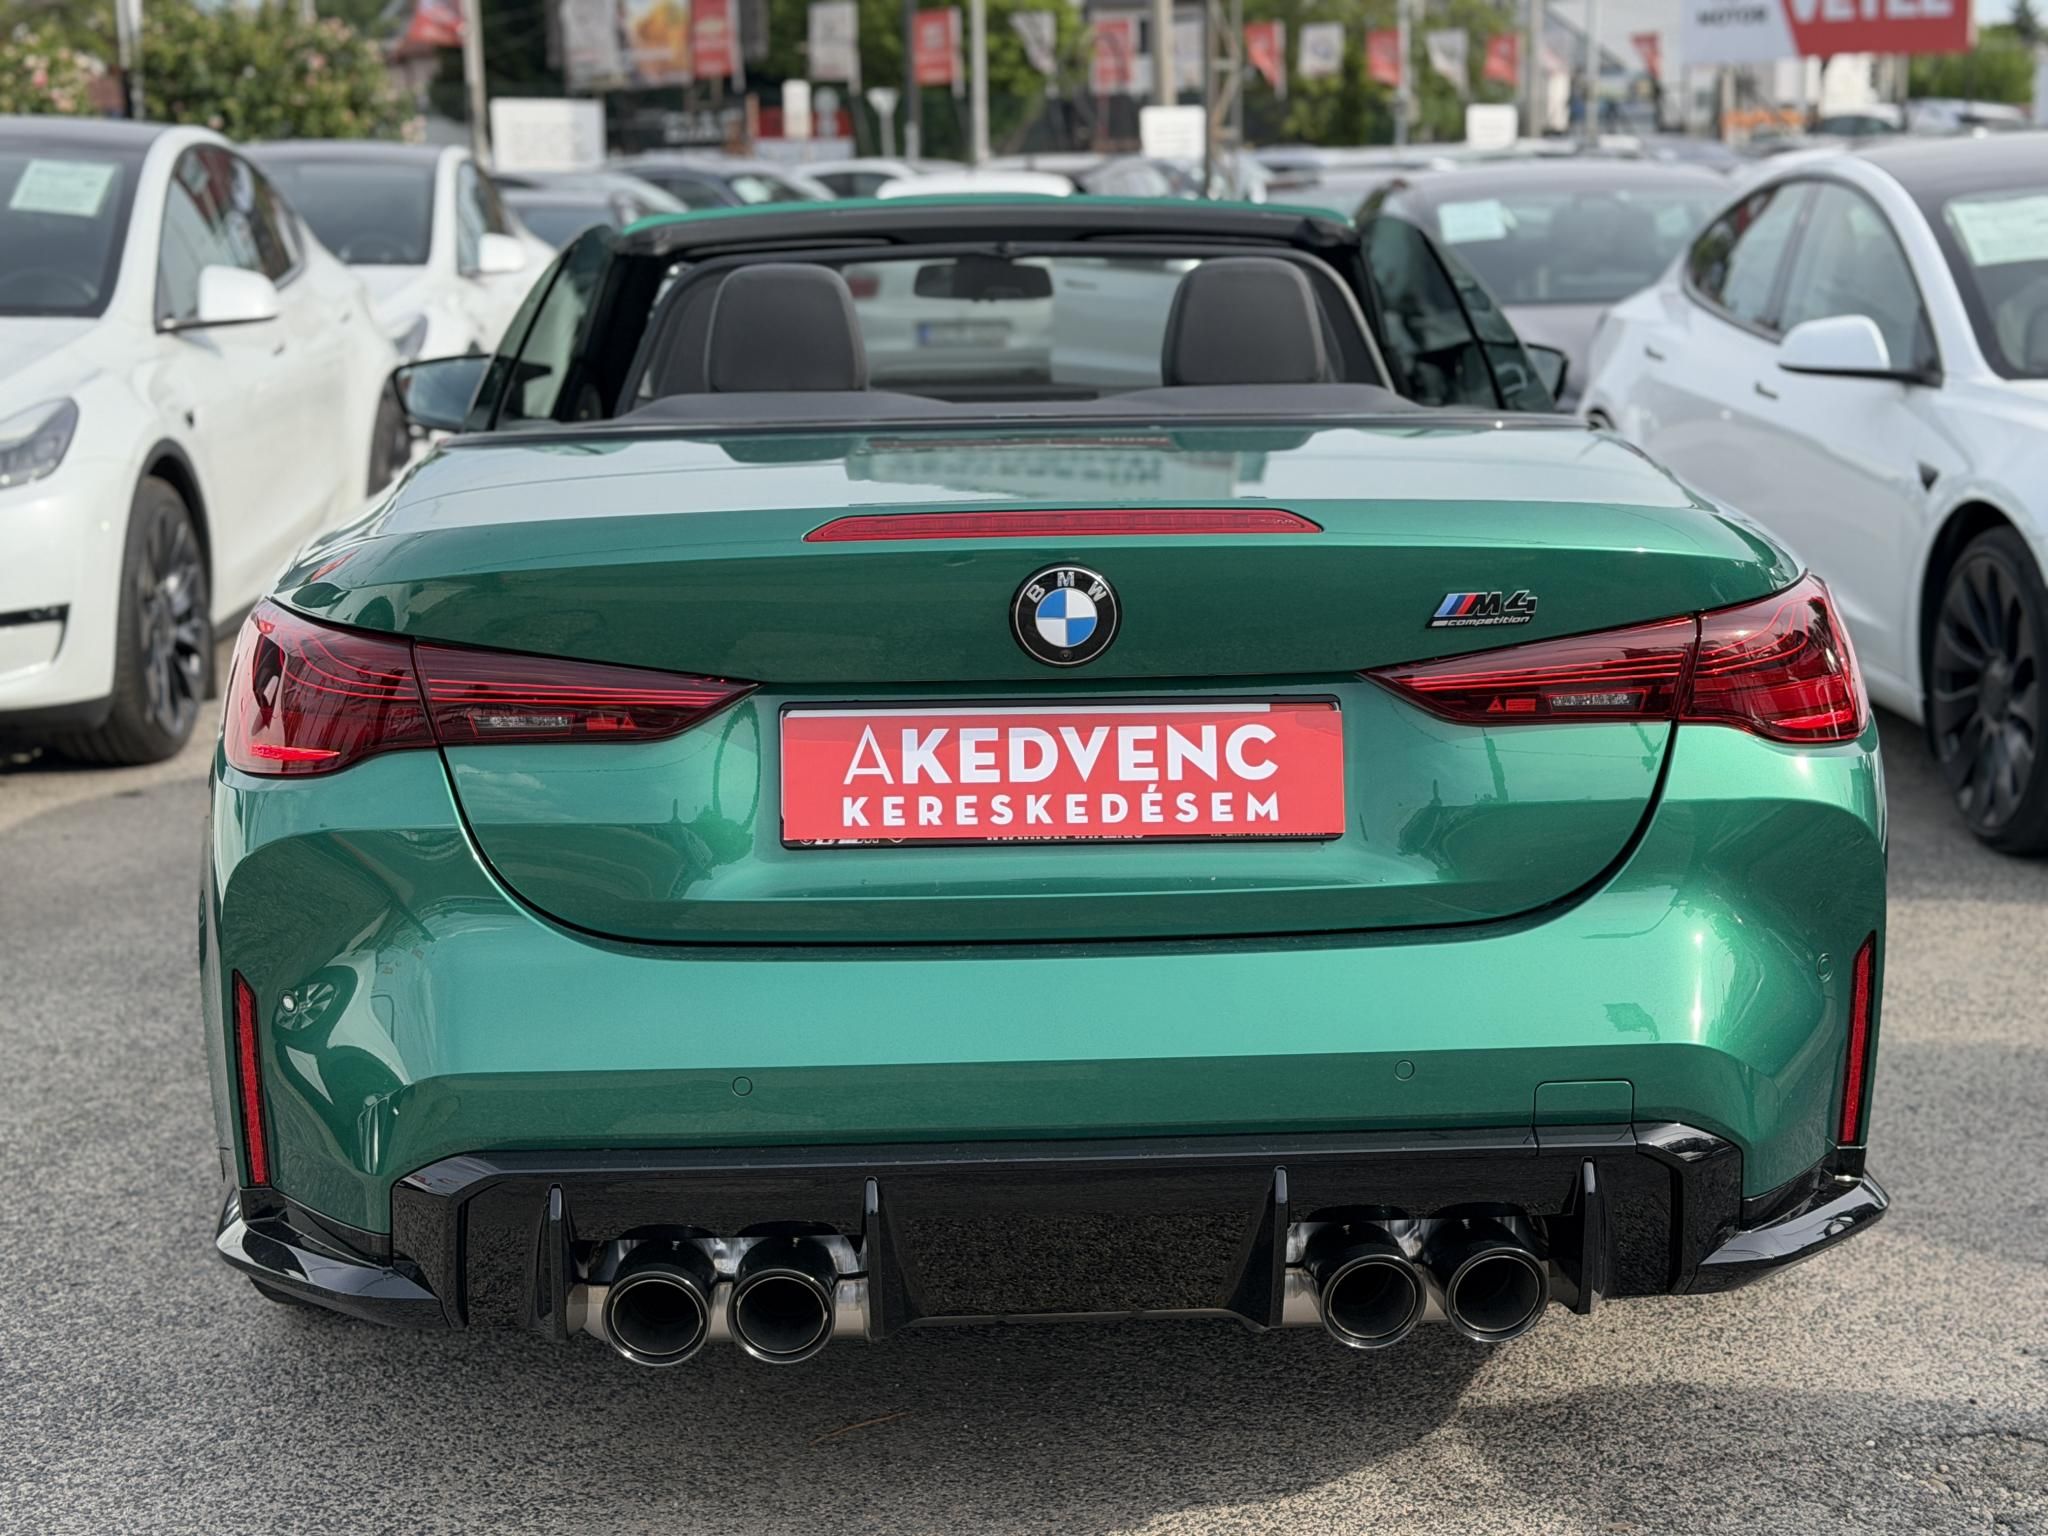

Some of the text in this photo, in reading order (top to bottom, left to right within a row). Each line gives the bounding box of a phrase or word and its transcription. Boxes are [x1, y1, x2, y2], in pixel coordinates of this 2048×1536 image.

[1026, 571, 1107, 603] BMW
[1447, 615, 1530, 627] competition
[842, 783, 1280, 827] KERESKEDÉSEM
